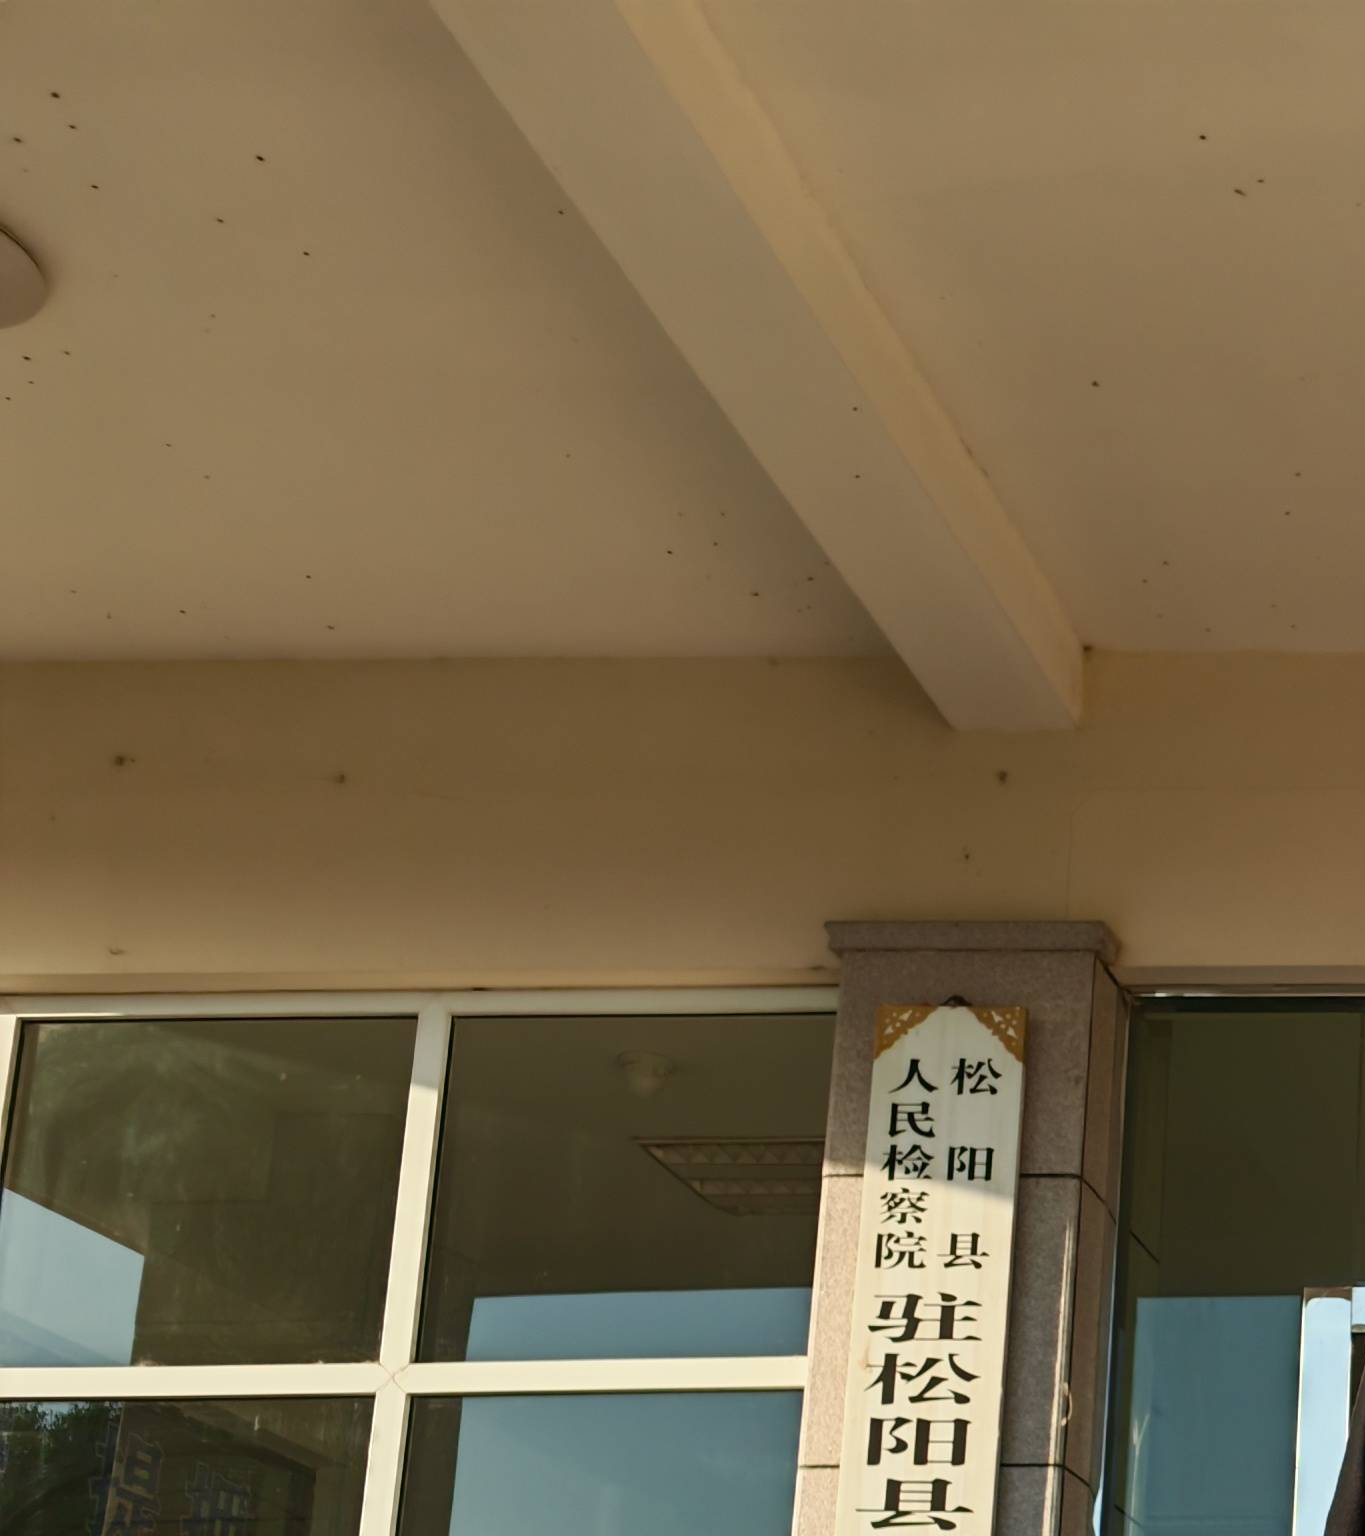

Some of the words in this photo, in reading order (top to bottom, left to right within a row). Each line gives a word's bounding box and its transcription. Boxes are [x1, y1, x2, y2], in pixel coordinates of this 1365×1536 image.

[873, 1056, 940, 1271] 人民检察院
[938, 1056, 1004, 1271] 松阳县
